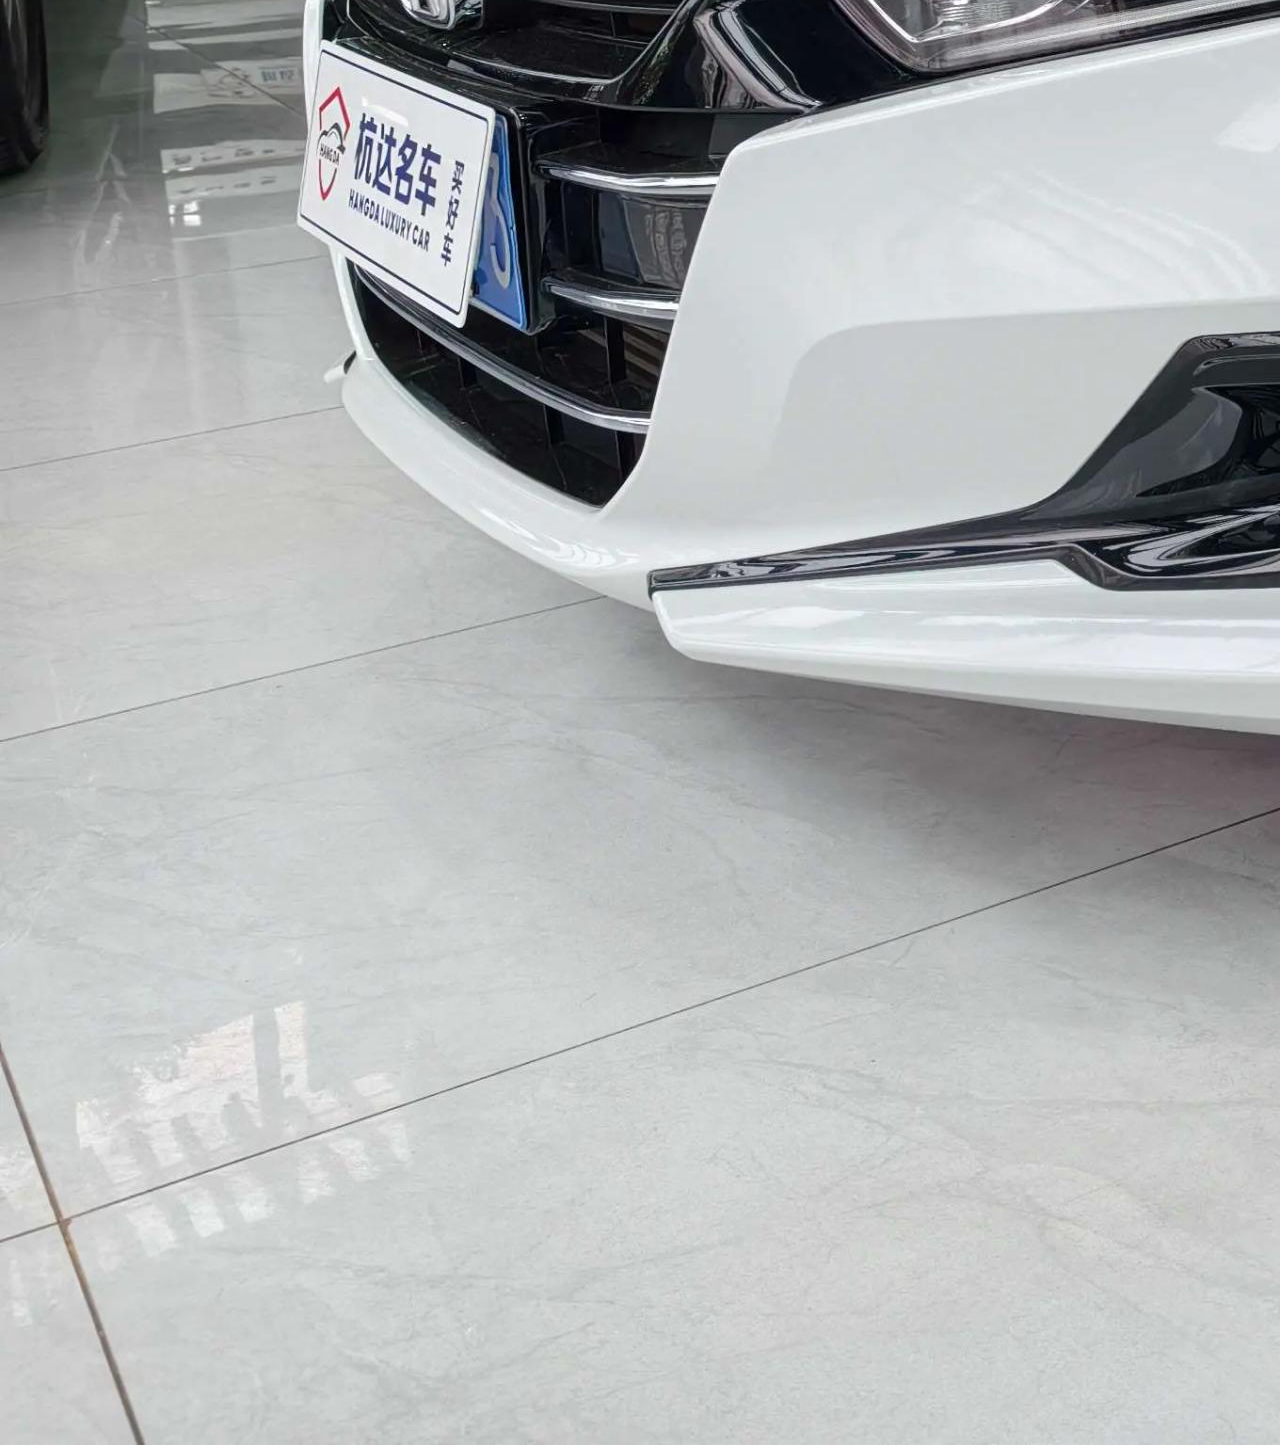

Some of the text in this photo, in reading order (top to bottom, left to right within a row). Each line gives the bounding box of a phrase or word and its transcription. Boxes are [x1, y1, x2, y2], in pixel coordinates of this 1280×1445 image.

[354, 112, 442, 217] 杭达名车
[440, 160, 465, 267] 买好车
[348, 188, 431, 253] HANGDA LUXURY CAR
